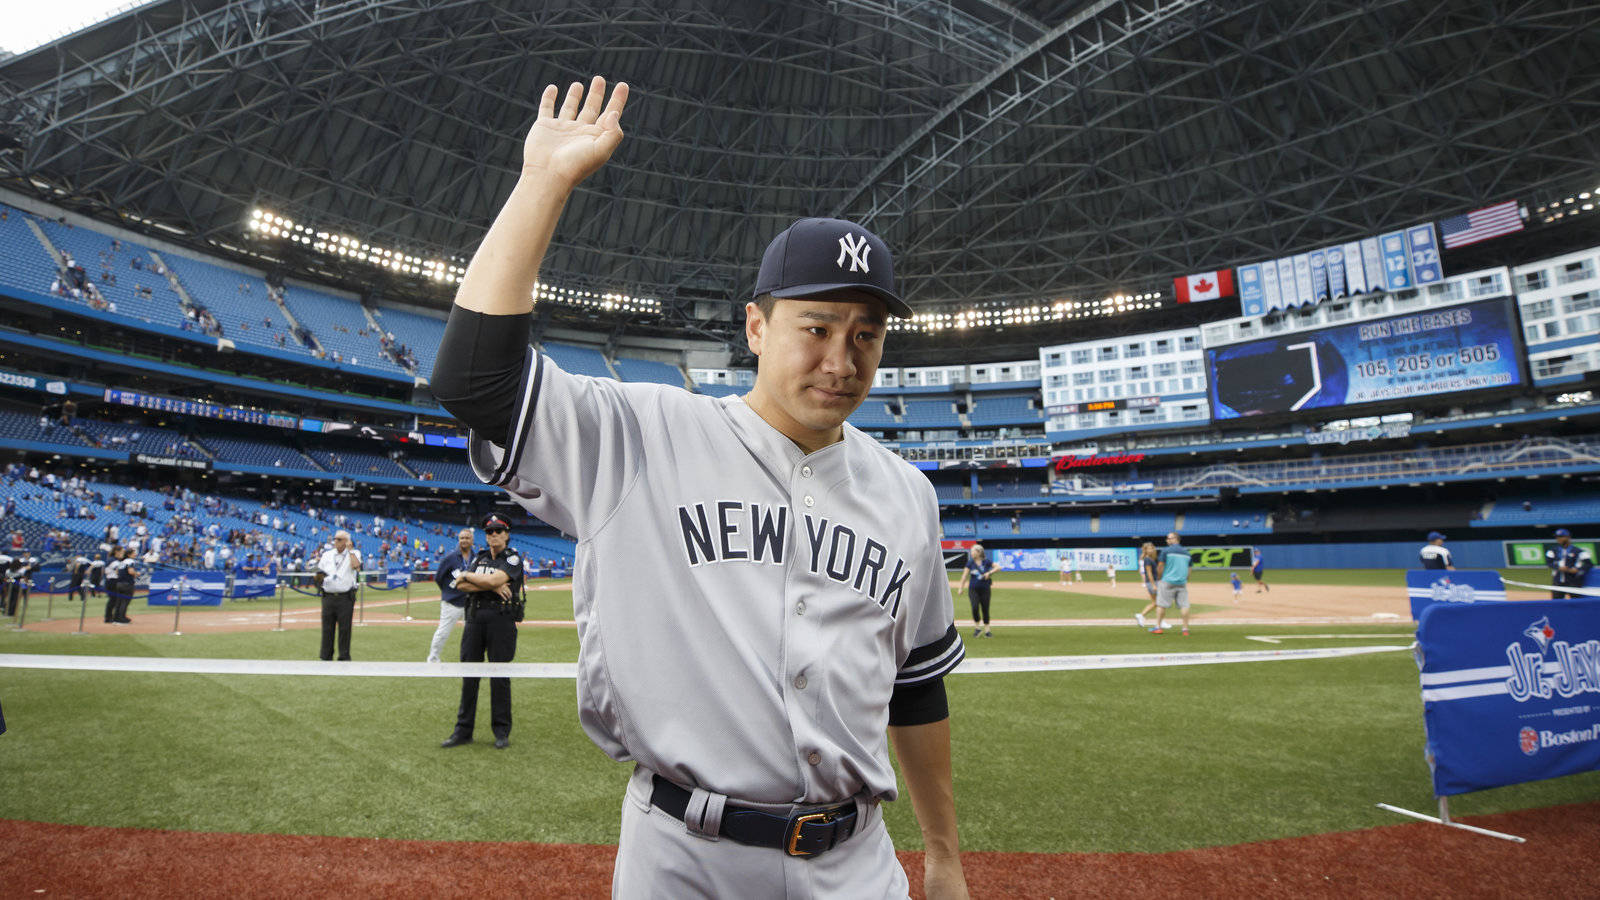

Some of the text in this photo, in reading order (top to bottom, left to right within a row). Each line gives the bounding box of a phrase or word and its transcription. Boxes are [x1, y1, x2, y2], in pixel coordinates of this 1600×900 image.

[836, 232, 871, 273] NY
[1386, 255, 1406, 272] 12
[1413, 248, 1438, 267] 32
[1359, 323, 1391, 341] RUN
[1392, 317, 1420, 335] THE
[1421, 308, 1472, 330] BASES
[1356, 343, 1500, 378] 105, 205 or 505
[1052, 451, 1145, 472] Budweiser
[677, 500, 911, 623] NEW YORK
[1056, 550, 1075, 561] RUN
[1079, 552, 1096, 560] THE
[1099, 553, 1130, 565] BASES
